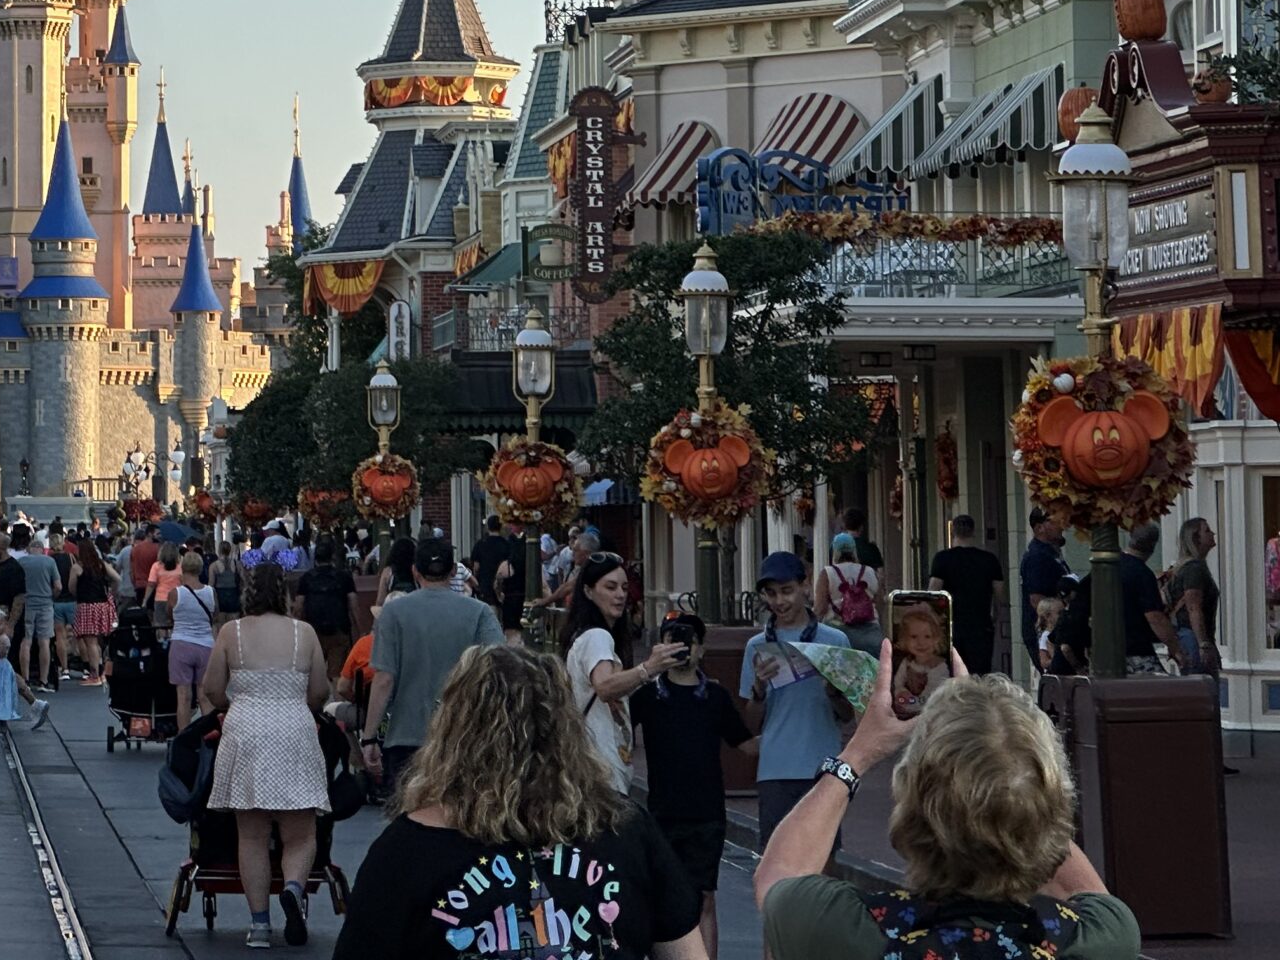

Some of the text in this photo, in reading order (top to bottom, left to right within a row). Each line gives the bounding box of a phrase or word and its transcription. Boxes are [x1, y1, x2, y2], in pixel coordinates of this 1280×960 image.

[585, 116, 605, 273] CRYSTAL ARTS
[1134, 200, 1189, 235] NOW SHOWING
[1147, 233, 1209, 271] MOUSETERPIECES
[431, 843, 620, 926] long live
[473, 897, 592, 954] all the
